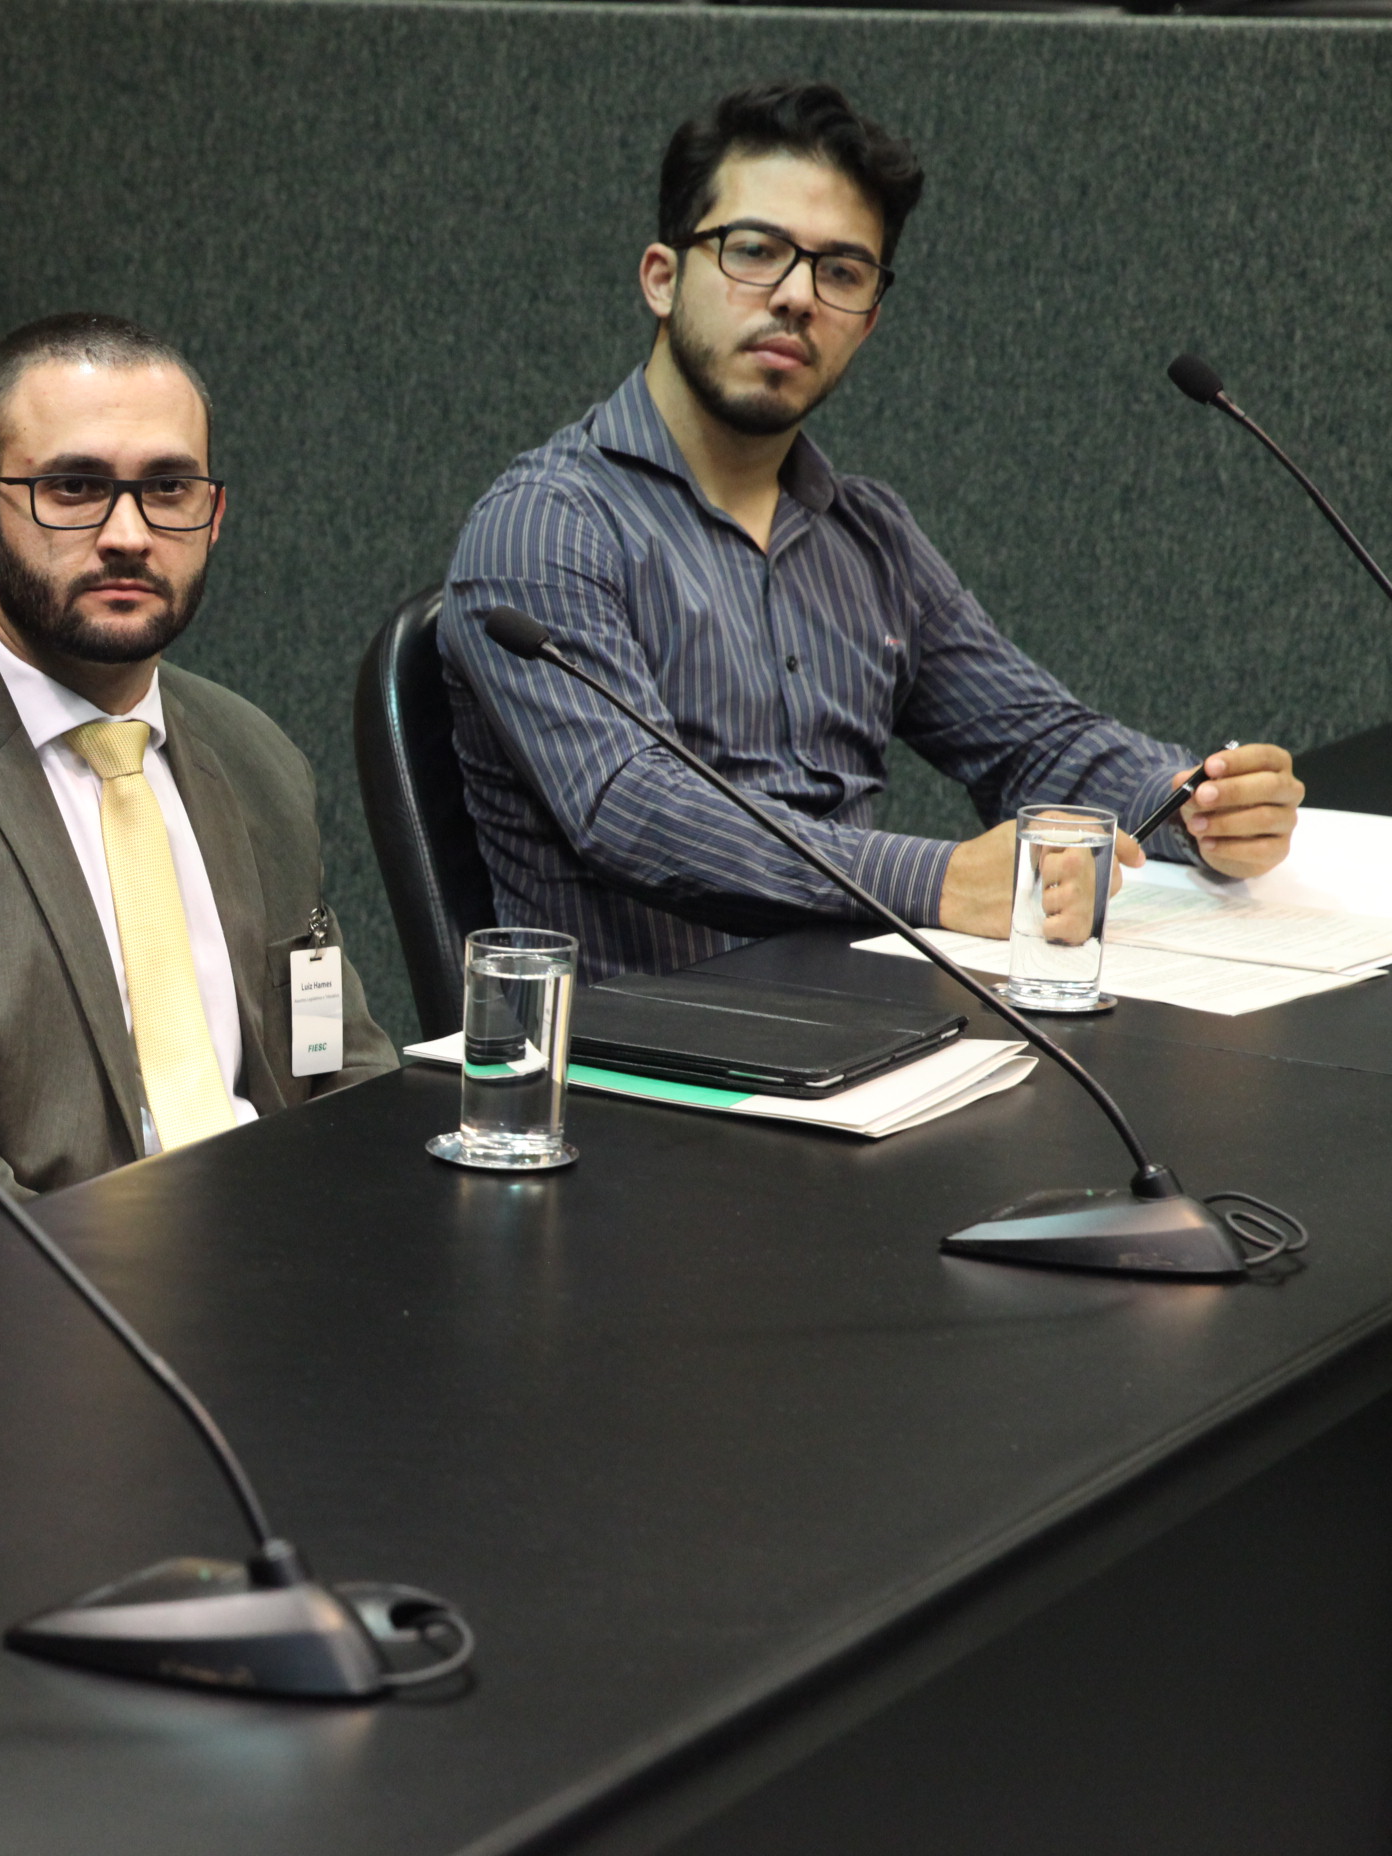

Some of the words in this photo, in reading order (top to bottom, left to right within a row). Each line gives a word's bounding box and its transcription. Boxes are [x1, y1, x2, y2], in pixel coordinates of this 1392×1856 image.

[301, 982, 313, 991] Luiz
[313, 980, 332, 989] Hames
[308, 1042, 327, 1053] FIESC
